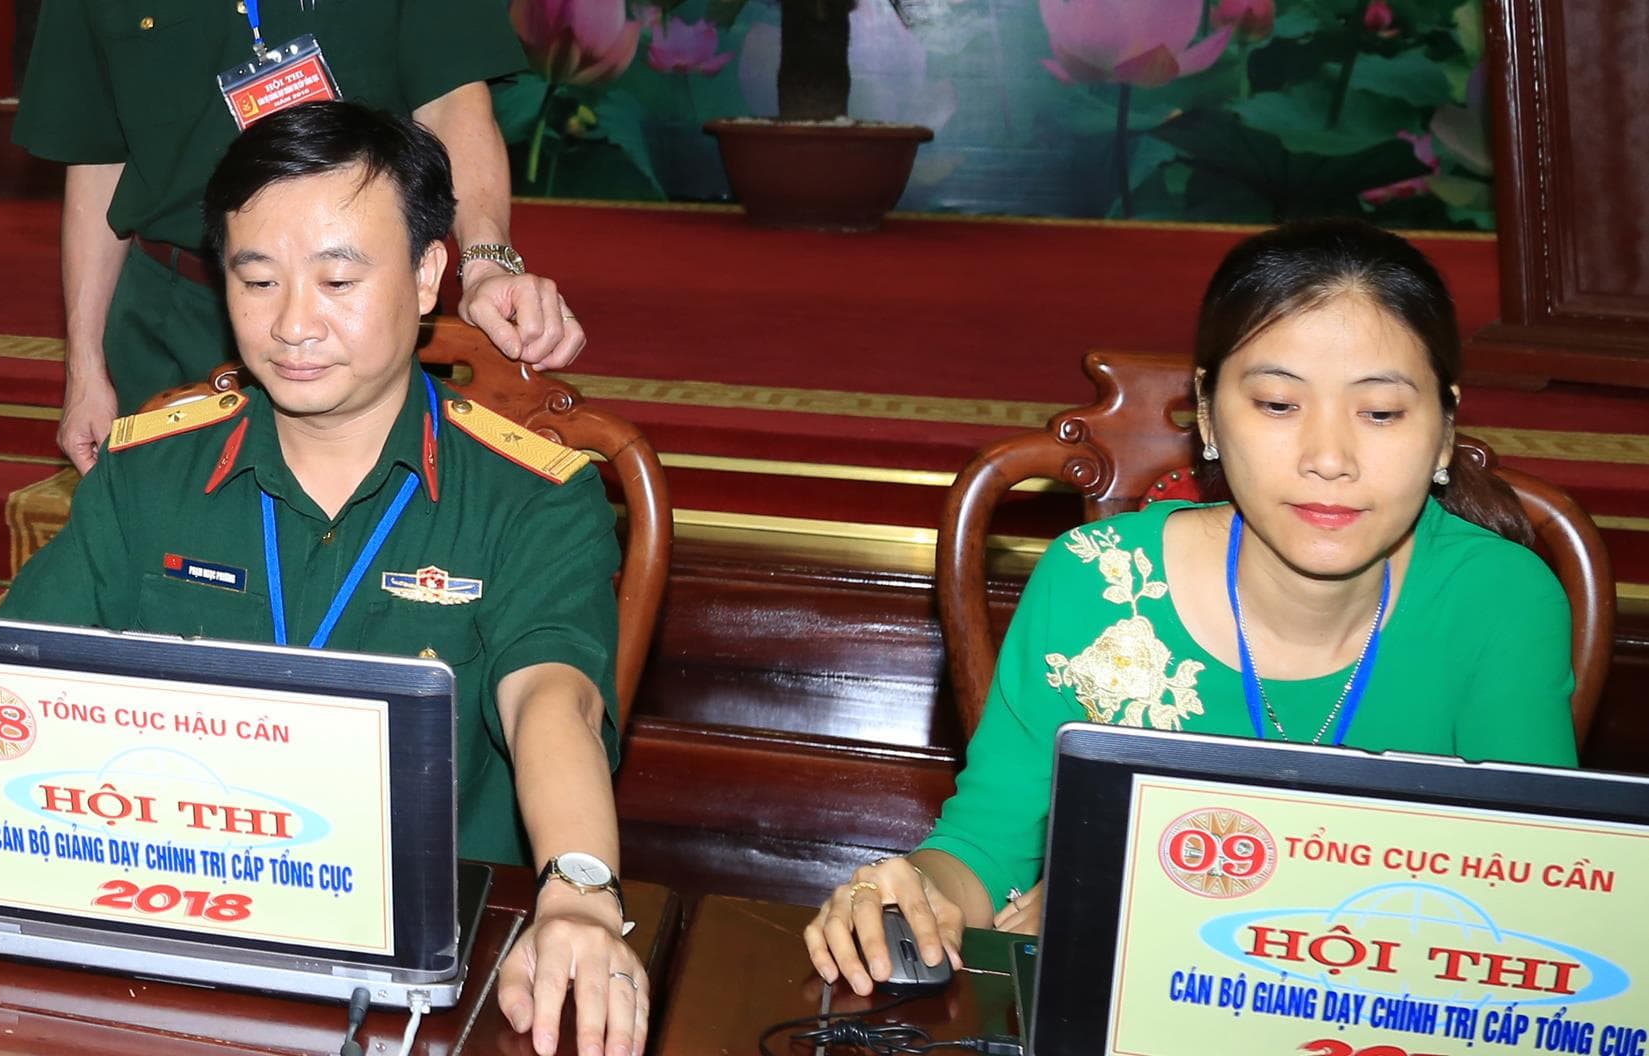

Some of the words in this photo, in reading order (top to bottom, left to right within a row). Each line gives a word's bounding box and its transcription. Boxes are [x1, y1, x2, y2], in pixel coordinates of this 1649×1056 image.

[38, 691, 106, 724] TỔNG
[115, 708, 165, 734] CỤC
[175, 712, 226, 740] HẬU
[236, 715, 289, 743] CẦN
[38, 783, 158, 826] HỘI
[178, 801, 293, 839] THI
[28, 825, 51, 862] BỘ
[55, 823, 104, 864] GIẢNG
[109, 838, 139, 872] DẠY
[146, 841, 196, 874] CHÍNH
[200, 850, 227, 884] TRỊ
[232, 846, 264, 882] CẤP
[269, 849, 314, 888] TỔNG
[319, 864, 353, 897] CỤC
[1169, 830, 1266, 877] 09
[1285, 827, 1372, 866] TỔNG
[1383, 848, 1450, 879] CỤC
[1461, 853, 1531, 887] HẬU
[1542, 858, 1615, 892] CẦN
[92, 879, 253, 922] 2018
[1244, 925, 1401, 975] HỘI
[1428, 947, 1581, 995] THI
[1170, 966, 1213, 1005] CÁN
[1218, 973, 1247, 1016] BỘ
[1252, 971, 1317, 1019] GIẢNG
[1322, 989, 1366, 1030] DẠY
[1370, 994, 1438, 1035] CHÍNH
[1444, 1005, 1479, 1047] TRỊ
[1483, 1002, 1529, 1046] CẤP
[1535, 1007, 1595, 1056] TỔNG
